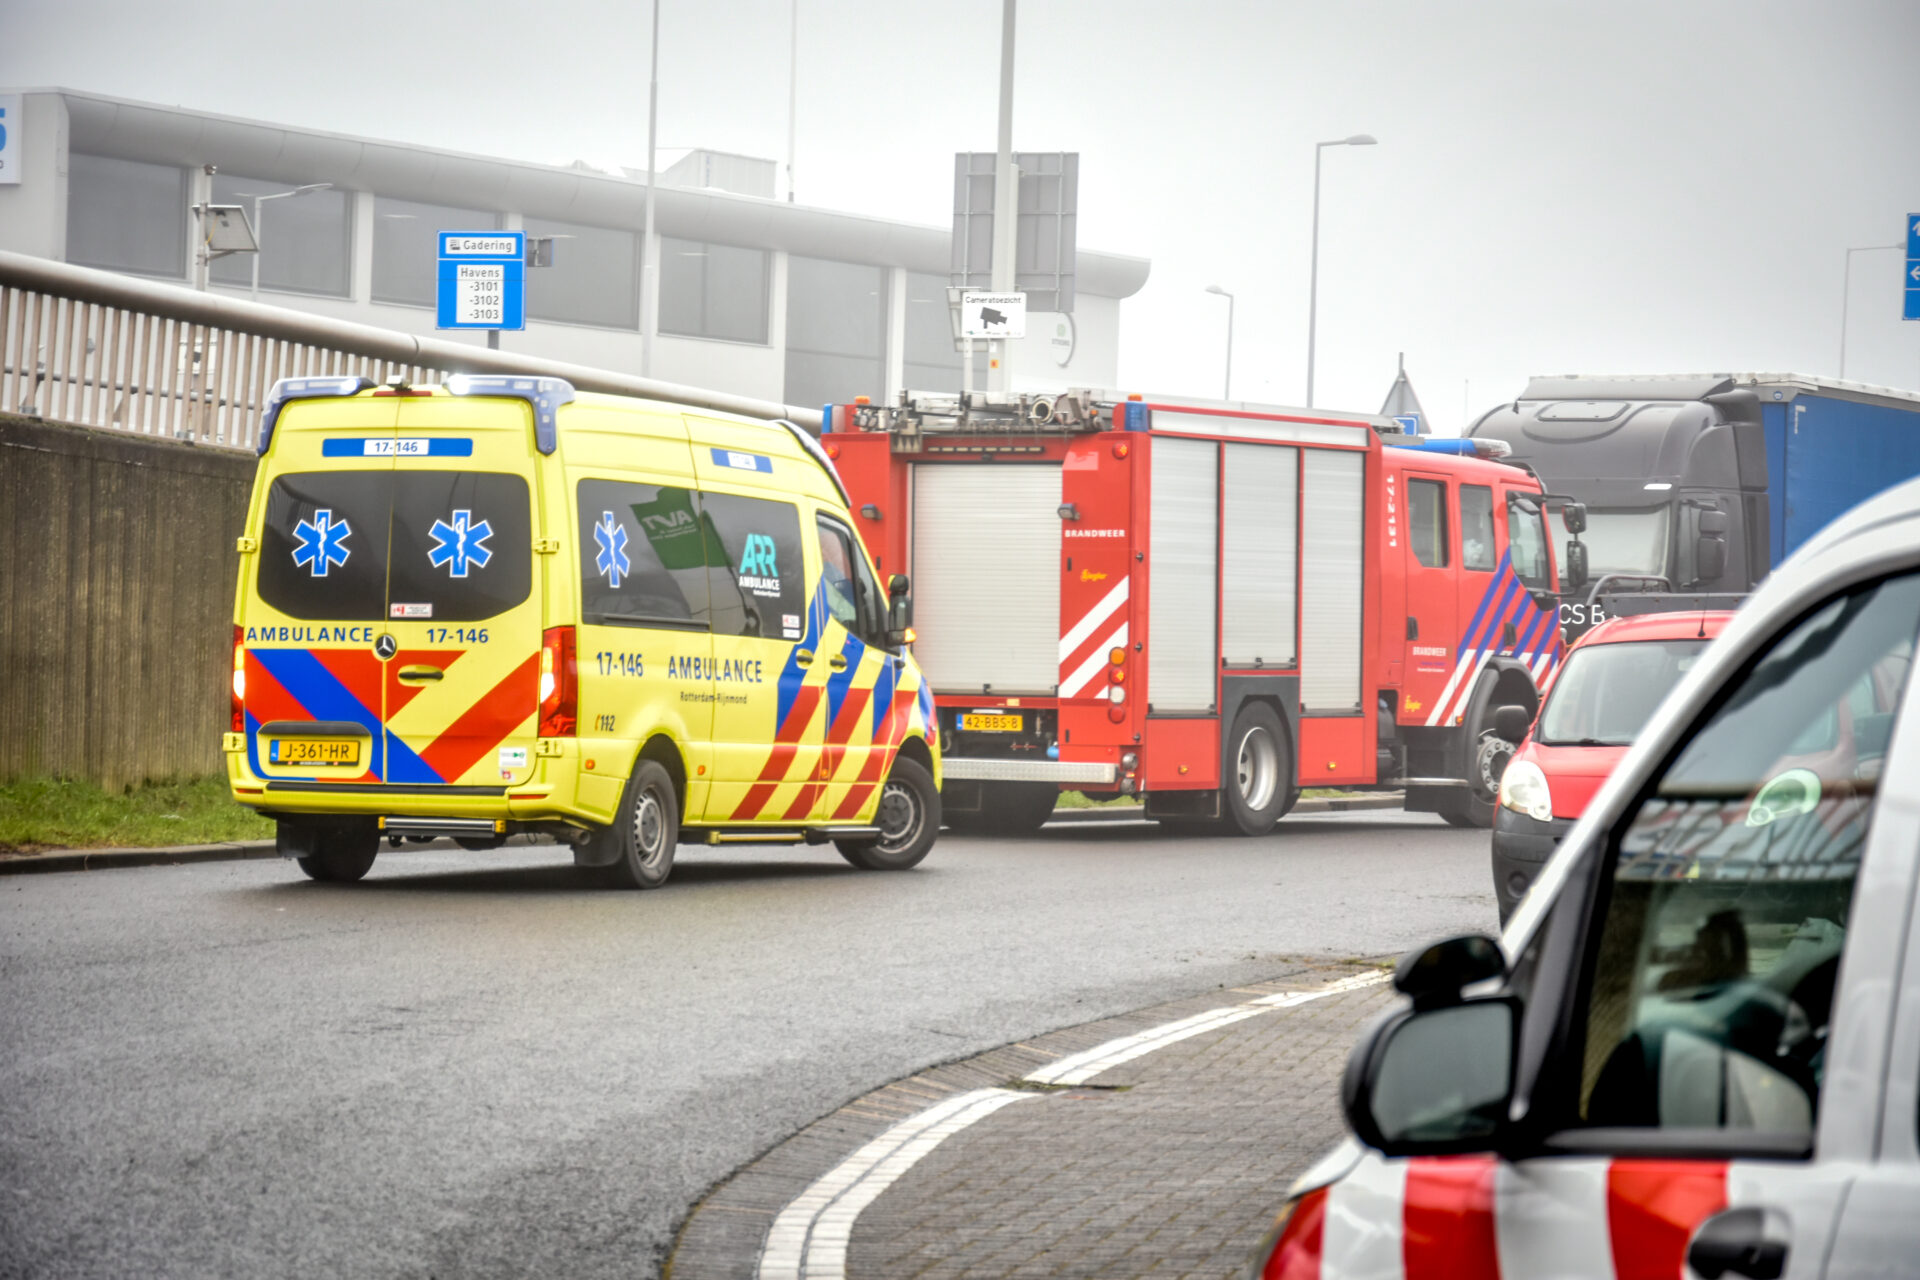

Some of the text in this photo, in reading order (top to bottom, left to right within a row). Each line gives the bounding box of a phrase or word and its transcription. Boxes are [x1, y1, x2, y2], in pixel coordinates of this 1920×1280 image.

[463, 240, 512, 252] Gadering
[461, 267, 500, 278] Havens
[469, 281, 498, 292] -3101
[469, 295, 499, 306] -3102
[965, 296, 1022, 304] Cameratoezicht
[469, 309, 499, 320] -3103
[375, 441, 418, 452] 17-146
[1064, 529, 1126, 538] BRANDWEER
[739, 533, 779, 578] ARR
[738, 576, 781, 591] AMBULANCE
[246, 626, 374, 642] AMBULANCE
[426, 628, 489, 644] 17-146
[596, 651, 644, 677] 17-146
[667, 655, 763, 683] AMBULANCE
[285, 743, 349, 759] J-361-HR
